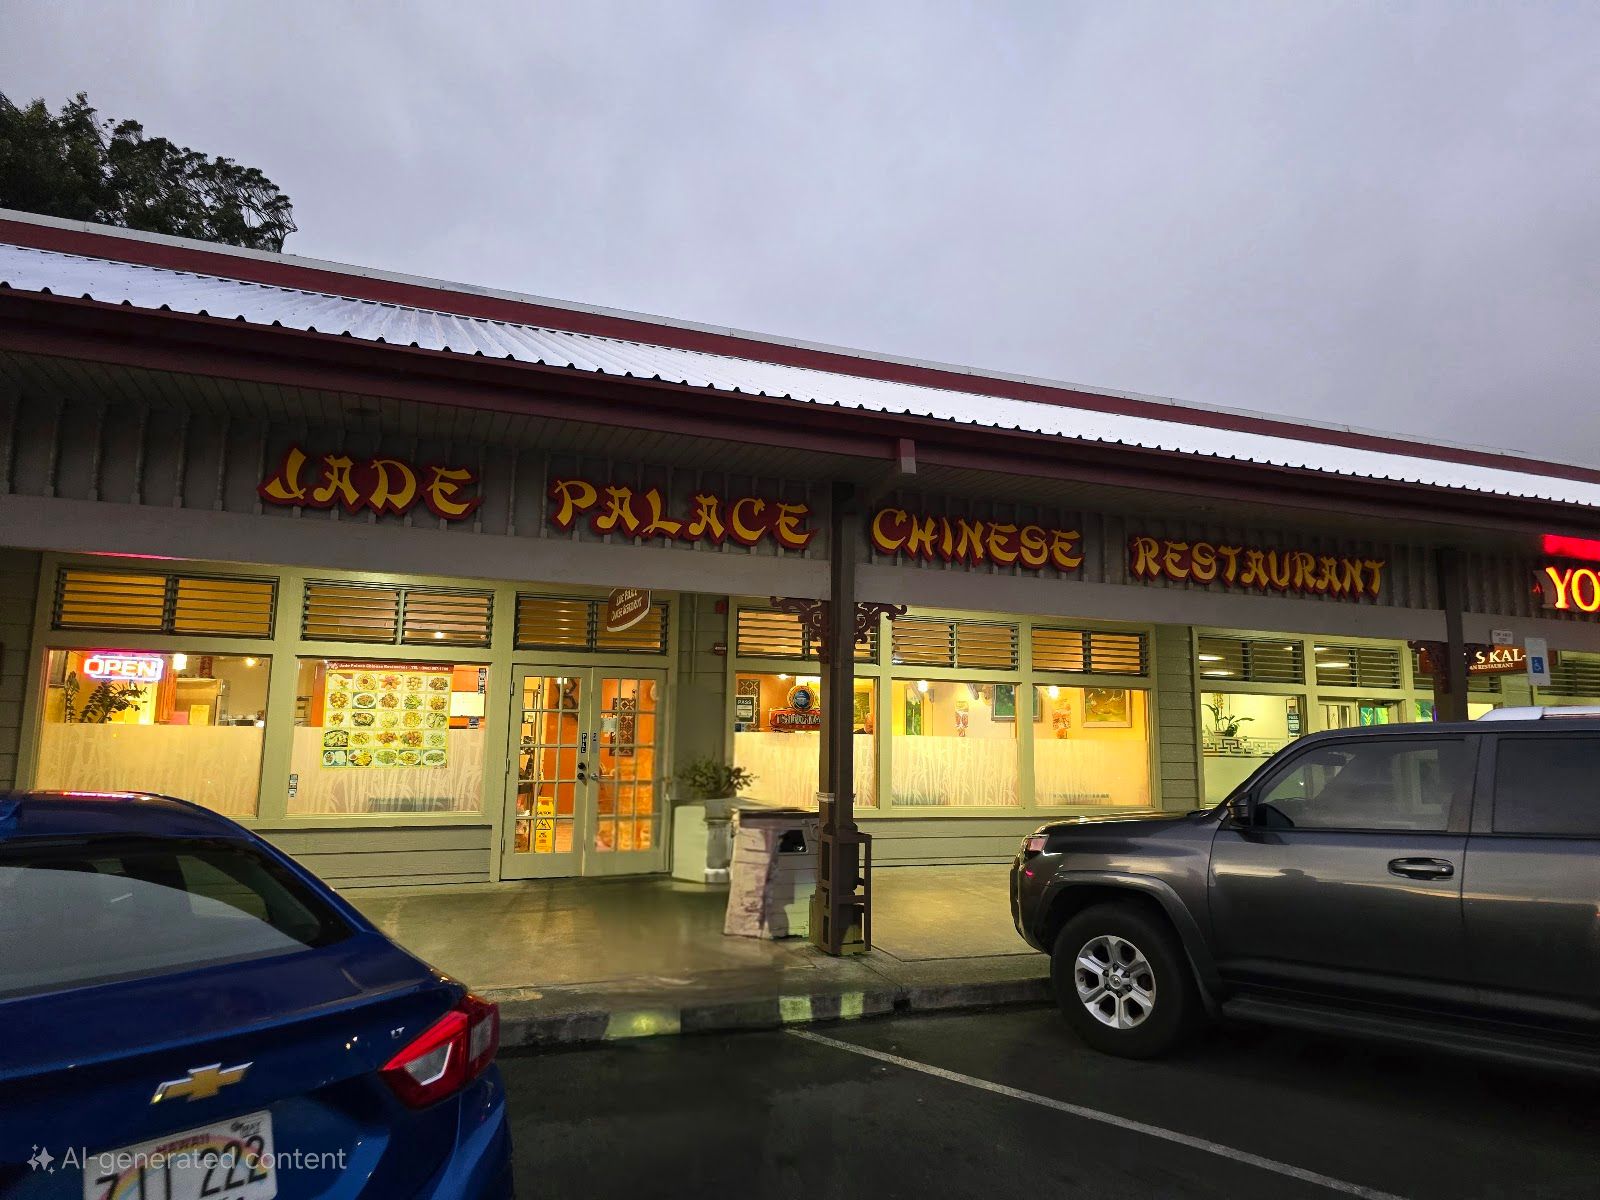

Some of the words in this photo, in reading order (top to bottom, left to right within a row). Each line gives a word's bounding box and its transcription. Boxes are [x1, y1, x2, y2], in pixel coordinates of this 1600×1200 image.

[263, 446, 473, 516] JADE
[552, 478, 811, 545] PALACE
[871, 507, 1082, 569] CHINESE
[1134, 536, 1386, 596] RESTAURANT
[1545, 566, 1600, 612] YO
[83, 658, 158, 678] OPEN
